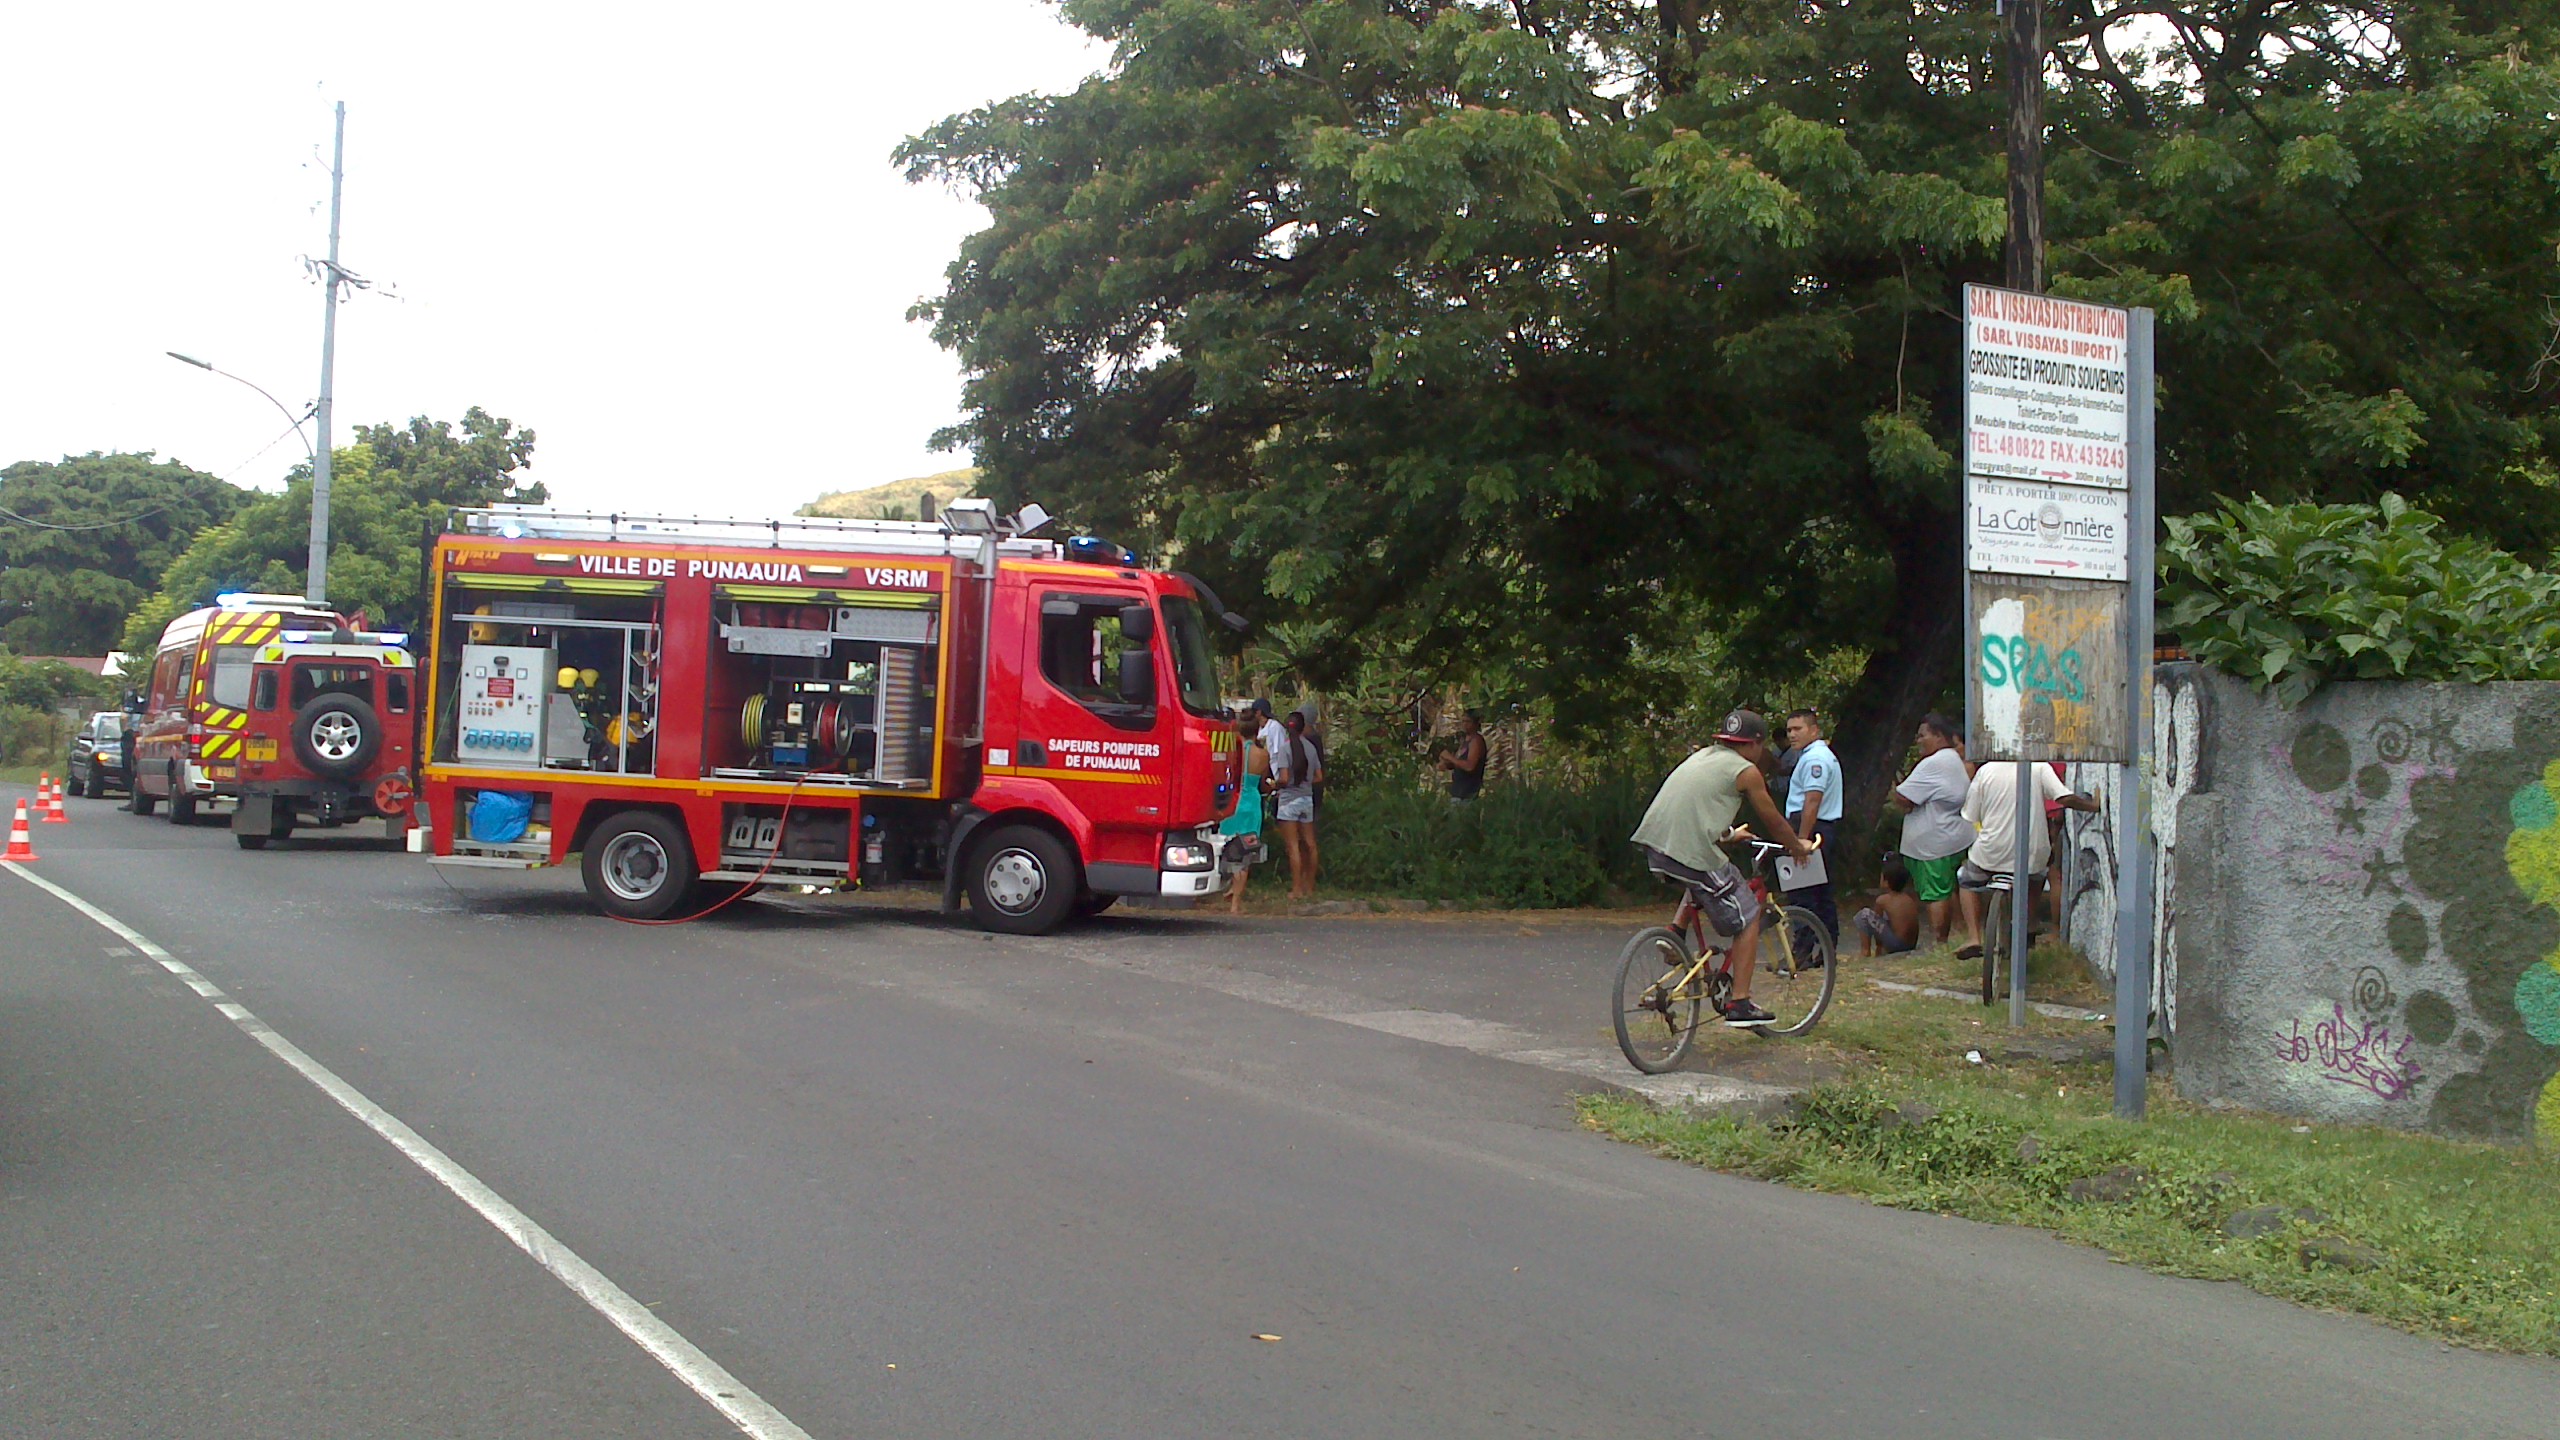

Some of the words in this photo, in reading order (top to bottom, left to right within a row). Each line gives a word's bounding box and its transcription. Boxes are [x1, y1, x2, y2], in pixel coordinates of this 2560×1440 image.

[1971, 287, 1999, 320] SARL
[2001, 292, 2051, 328] VISSAYAS
[2053, 301, 2124, 340] DISTRIBUTION
[2015, 331, 2069, 354] VISSAYAS
[1969, 350, 2019, 379] GROSSISTE
[2020, 357, 2032, 381] EN
[2034, 358, 2077, 389] PRODUITS
[2077, 366, 2125, 395] SOUVENIRS
[1974, 414, 2007, 430] Meuble
[2015, 487, 2056, 501] PORTER
[2079, 493, 2117, 508] COTON
[1977, 506, 1999, 528] La
[579, 555, 641, 575] VILLE
[647, 557, 677, 577] DE
[687, 559, 803, 582] PUNAAUIA
[864, 567, 929, 588] VSRM
[1048, 738, 1101, 755] SAPEURS
[1102, 741, 1160, 757] POMPIERS
[1065, 754, 1080, 769] DE
[1082, 755, 1141, 772] PUNAAUIA
